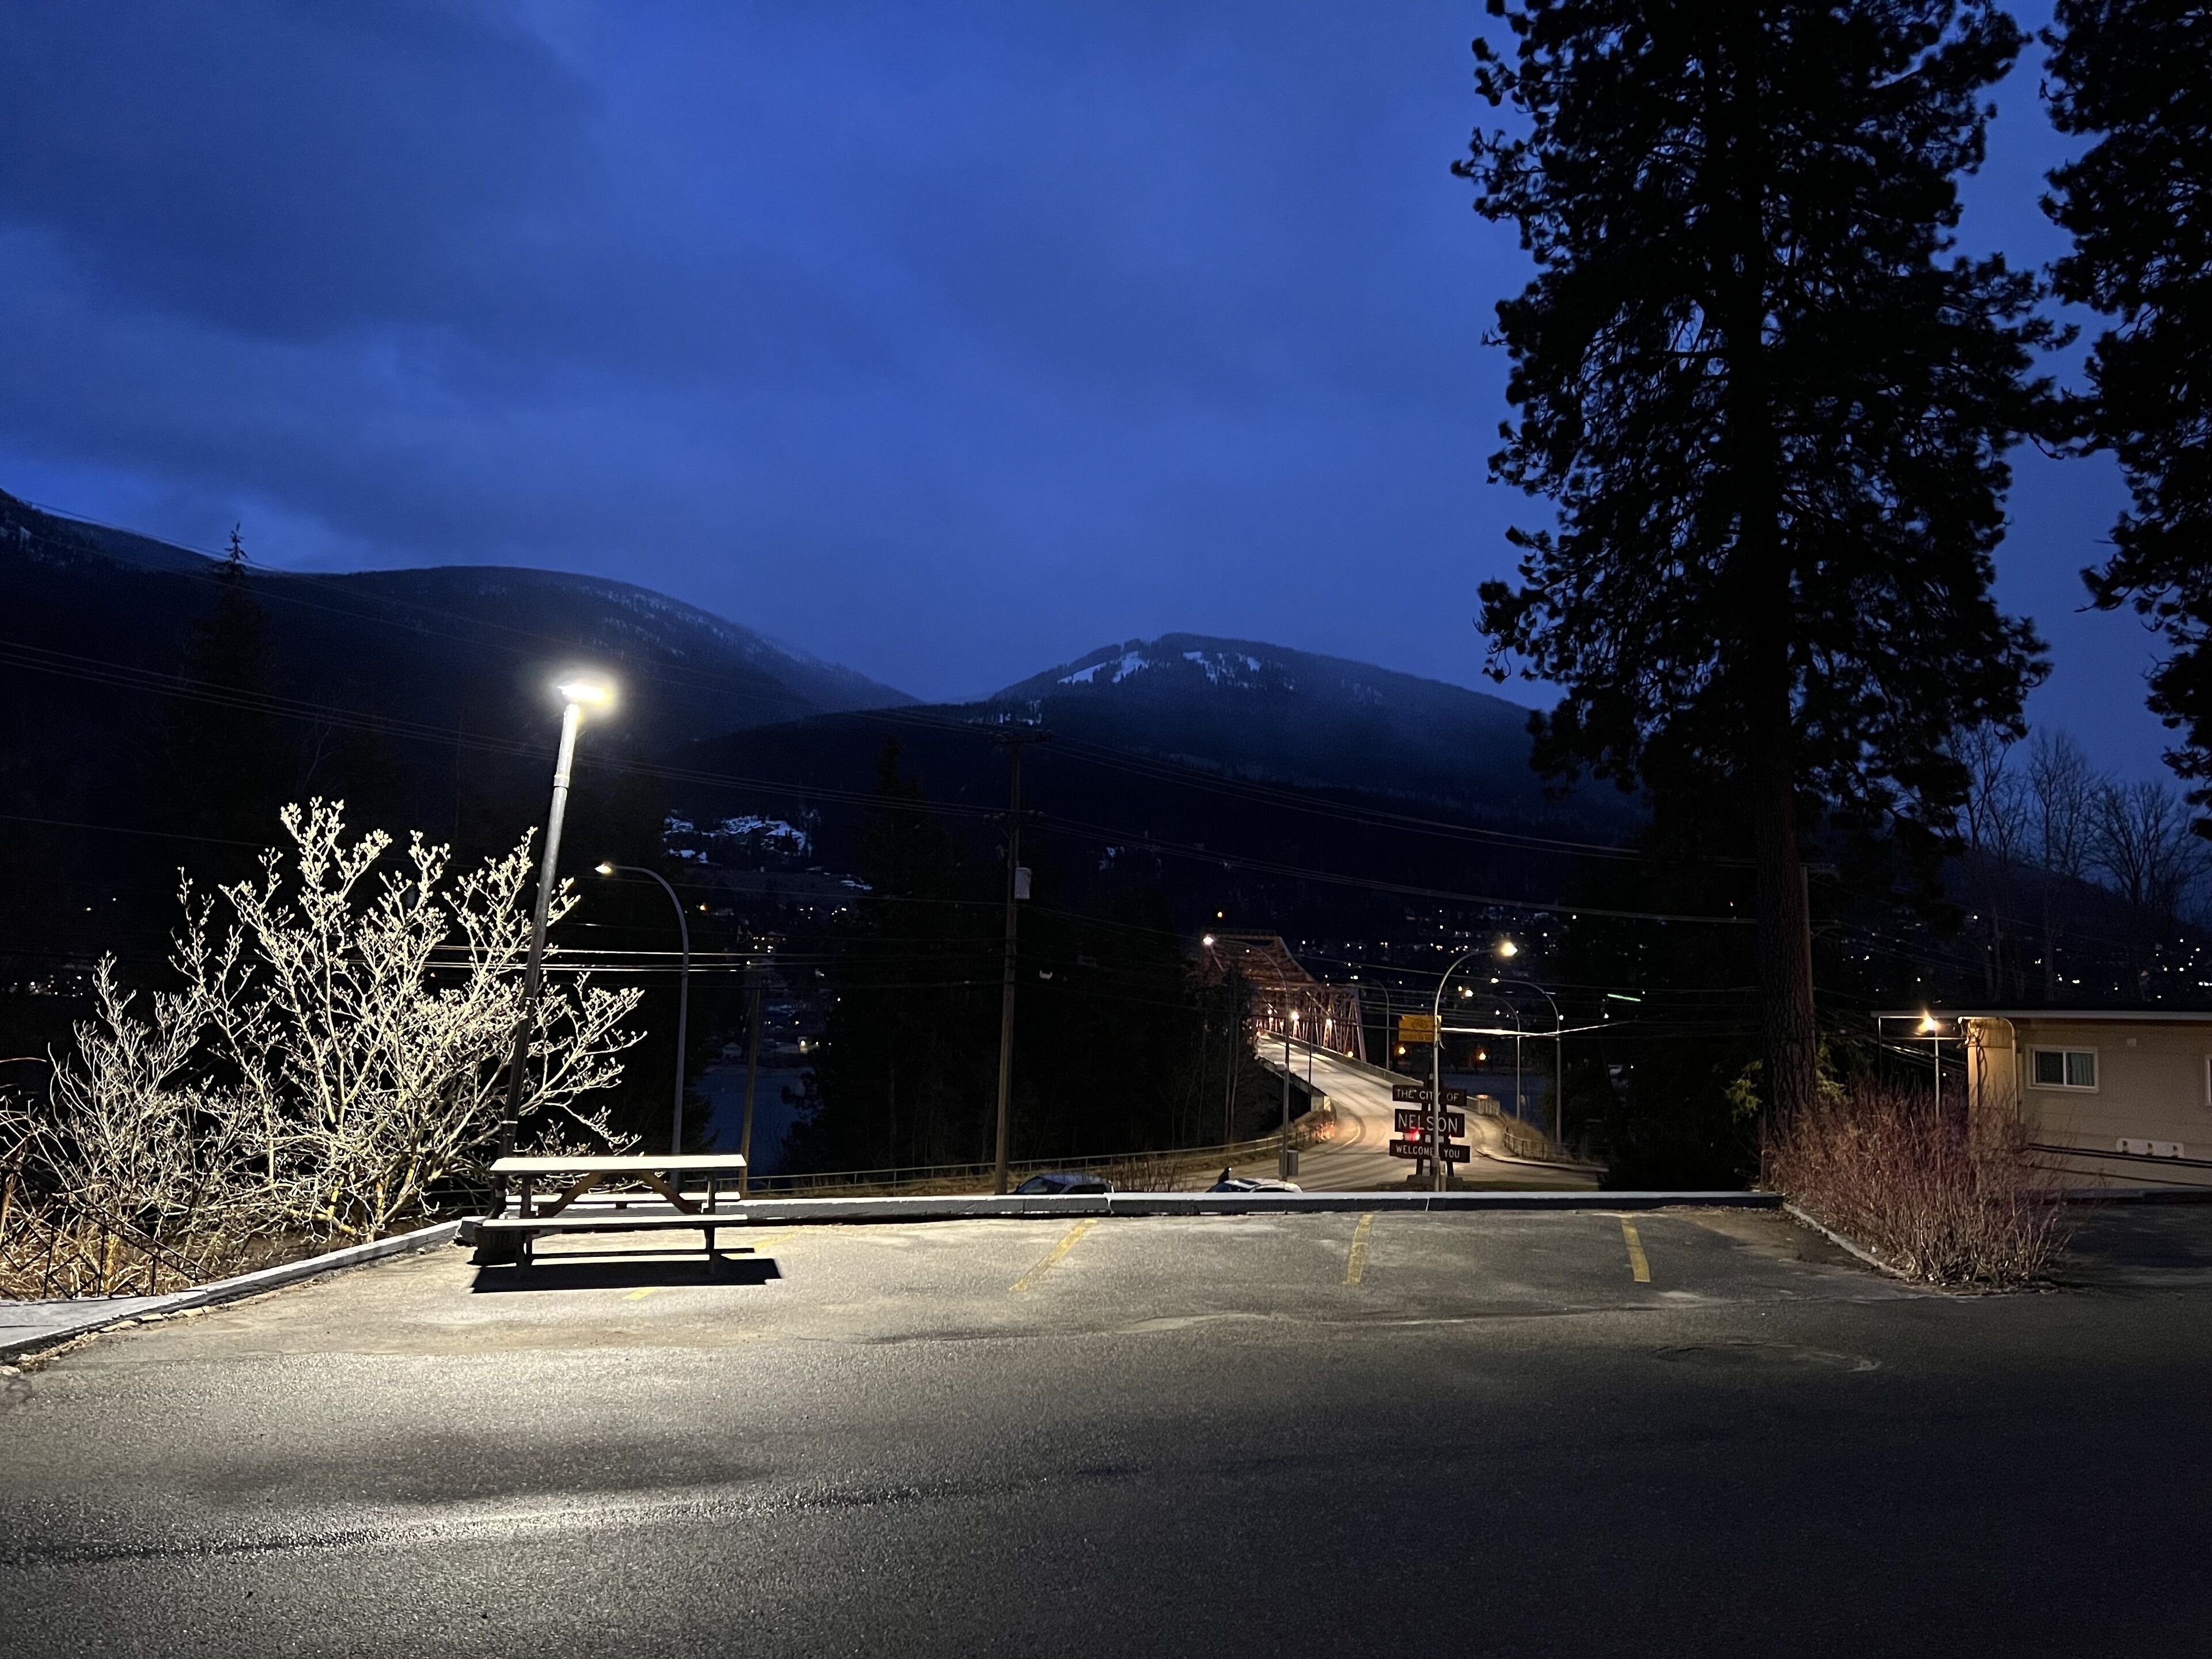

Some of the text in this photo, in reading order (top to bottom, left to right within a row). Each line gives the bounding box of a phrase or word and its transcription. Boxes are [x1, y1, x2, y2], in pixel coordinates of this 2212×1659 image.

[1397, 1089, 1416, 1099] THE
[1446, 1093, 1460, 1102] OF
[1398, 1113, 1457, 1133] NELSON
[1396, 1145, 1460, 1158] WELCOME YOU
